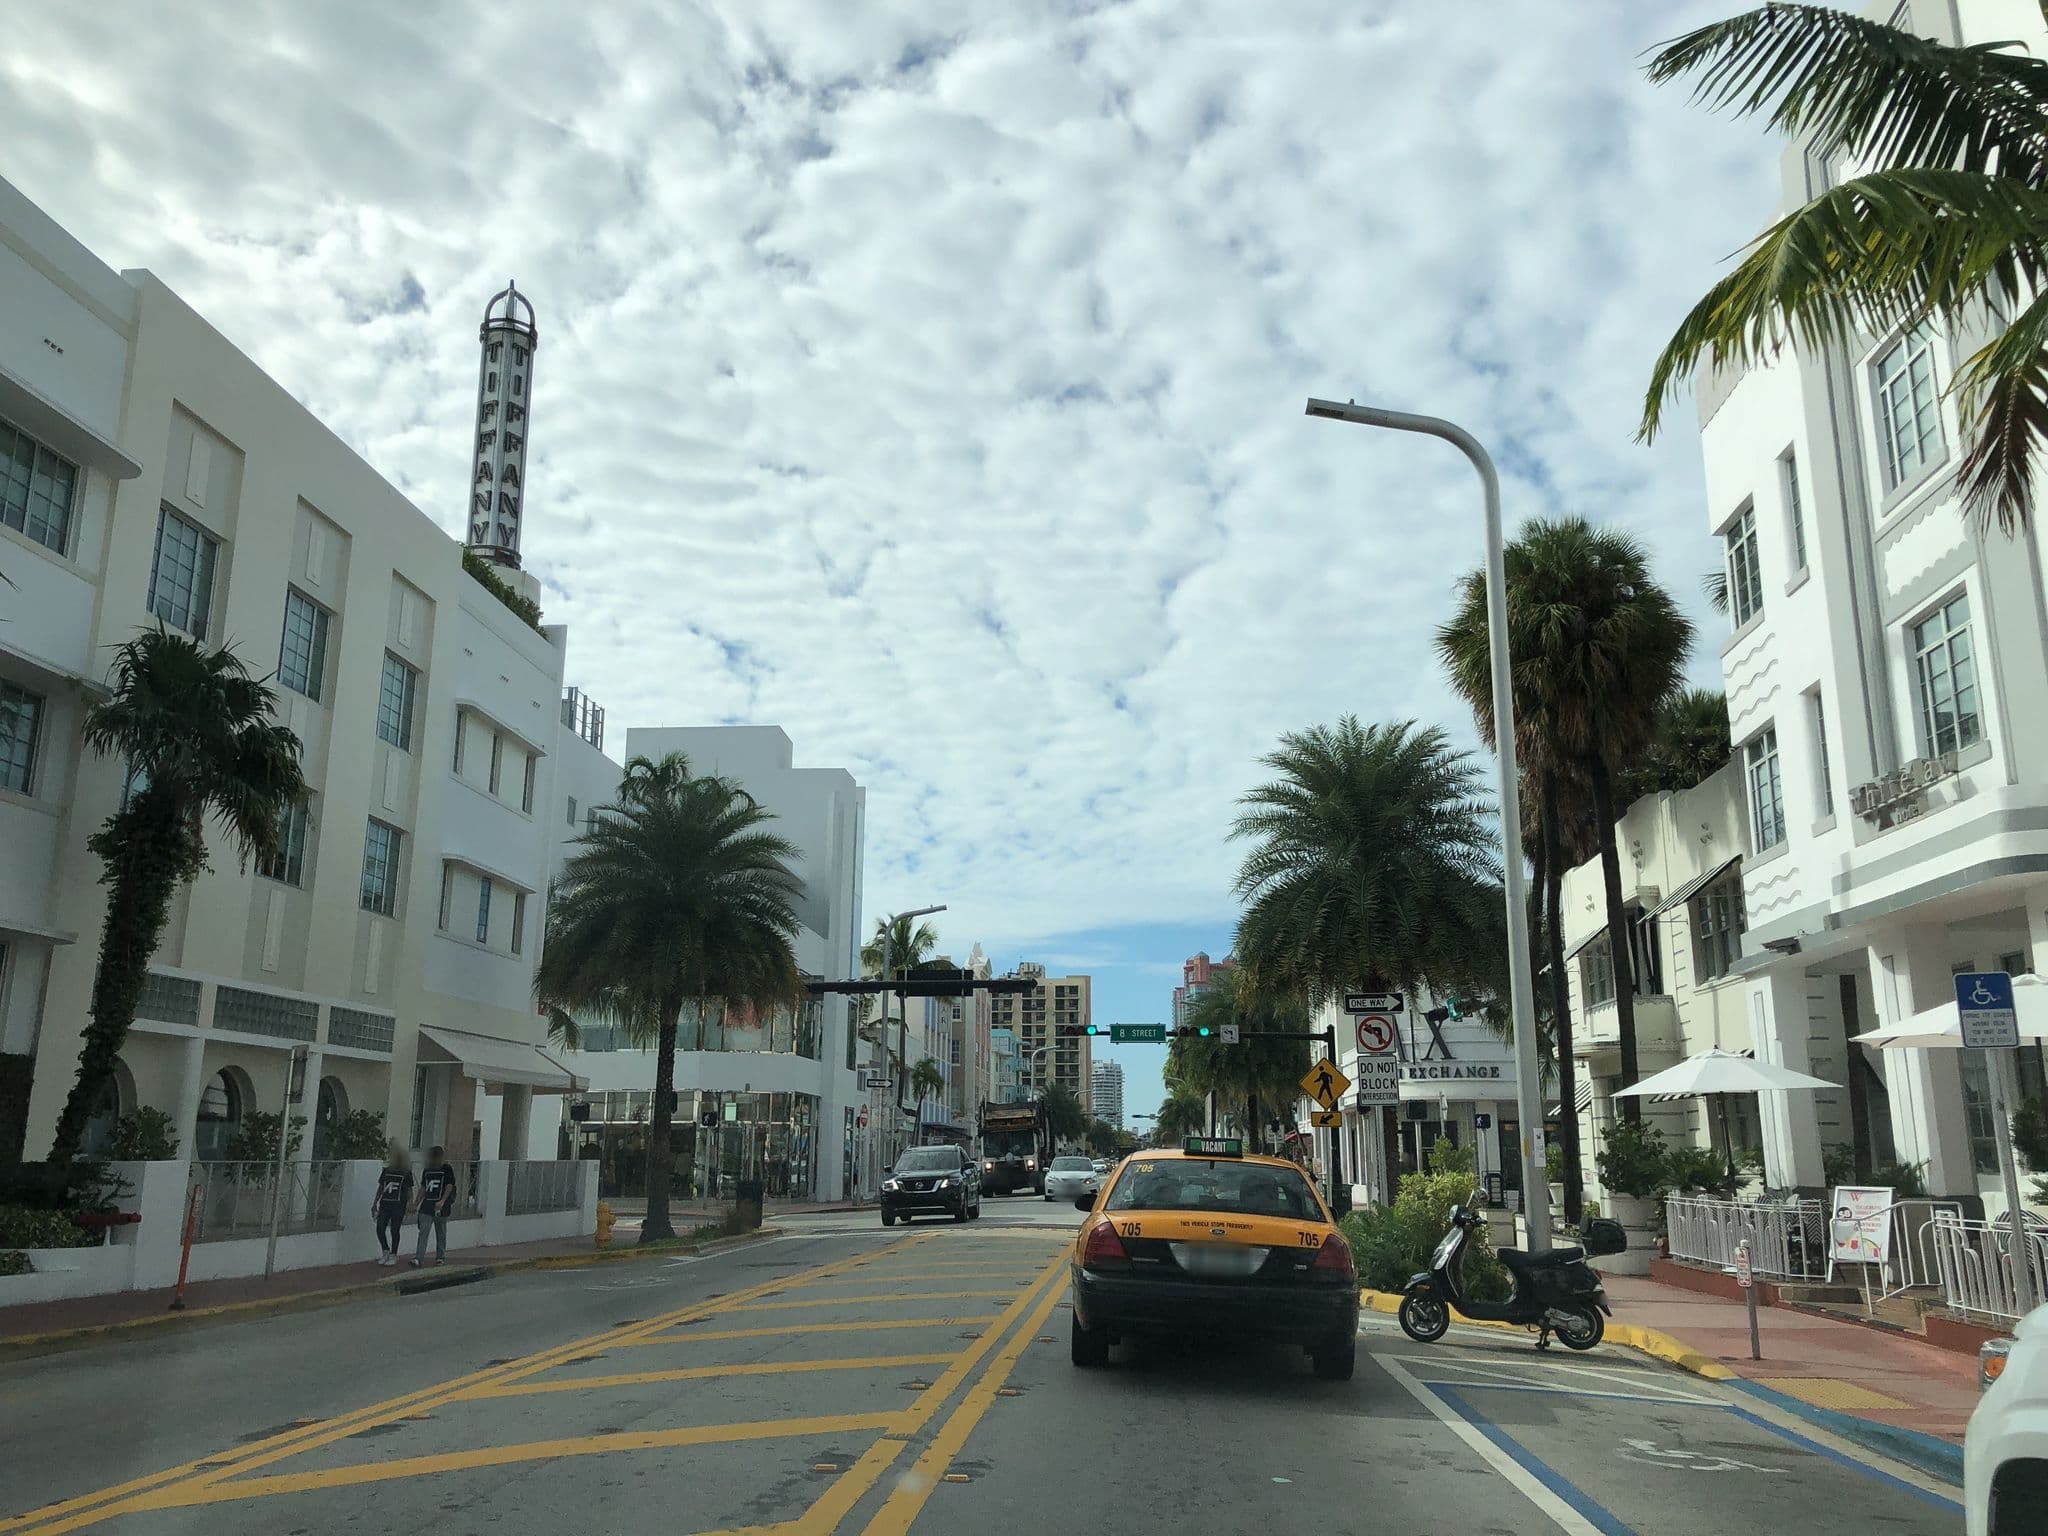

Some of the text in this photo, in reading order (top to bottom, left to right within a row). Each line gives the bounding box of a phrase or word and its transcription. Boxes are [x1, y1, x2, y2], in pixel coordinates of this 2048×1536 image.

[471, 341, 504, 545] TIFFANY
[497, 341, 530, 547] TIFFANY
[1351, 999, 1386, 1008] ONE WAY
[1119, 1028, 1157, 1038] 8 STREET
[1360, 1062, 1374, 1074] DO
[1377, 1062, 1395, 1074] NOT
[1409, 1066, 1500, 1080] EXCHANGE
[1361, 1078, 1397, 1090] BLOCK
[1361, 1092, 1398, 1101] INTERSECTION
[1201, 1141, 1227, 1153] VACANT
[1135, 1164, 1154, 1173] 705
[1121, 1222, 1141, 1237] 705
[1298, 1231, 1320, 1247] 705
